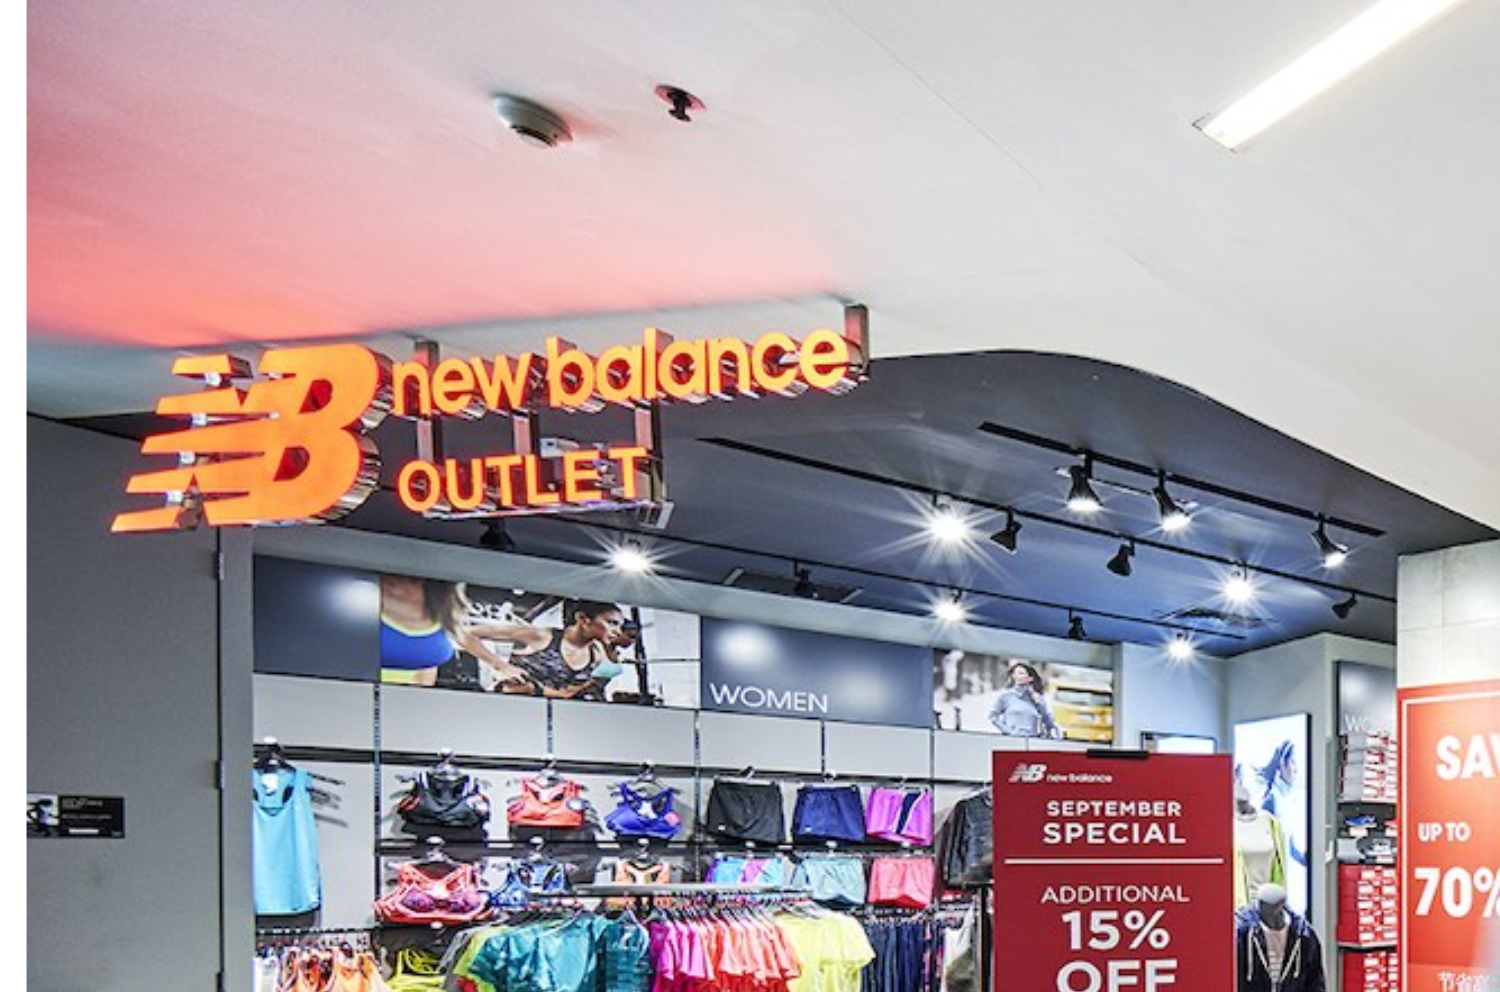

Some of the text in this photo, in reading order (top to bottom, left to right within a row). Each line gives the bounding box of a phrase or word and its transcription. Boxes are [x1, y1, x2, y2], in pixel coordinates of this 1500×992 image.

[547, 327, 848, 407] balance
[398, 446, 647, 512] OUTLET
[709, 682, 828, 714] WOMEN
[1046, 800, 1182, 817] SEPTEMBER
[1043, 822, 1186, 845] SPECIAL
[1418, 822, 1470, 842] UP TO
[1041, 885, 1190, 904] ADDITIONAL
[1062, 909, 1170, 950] 15%
